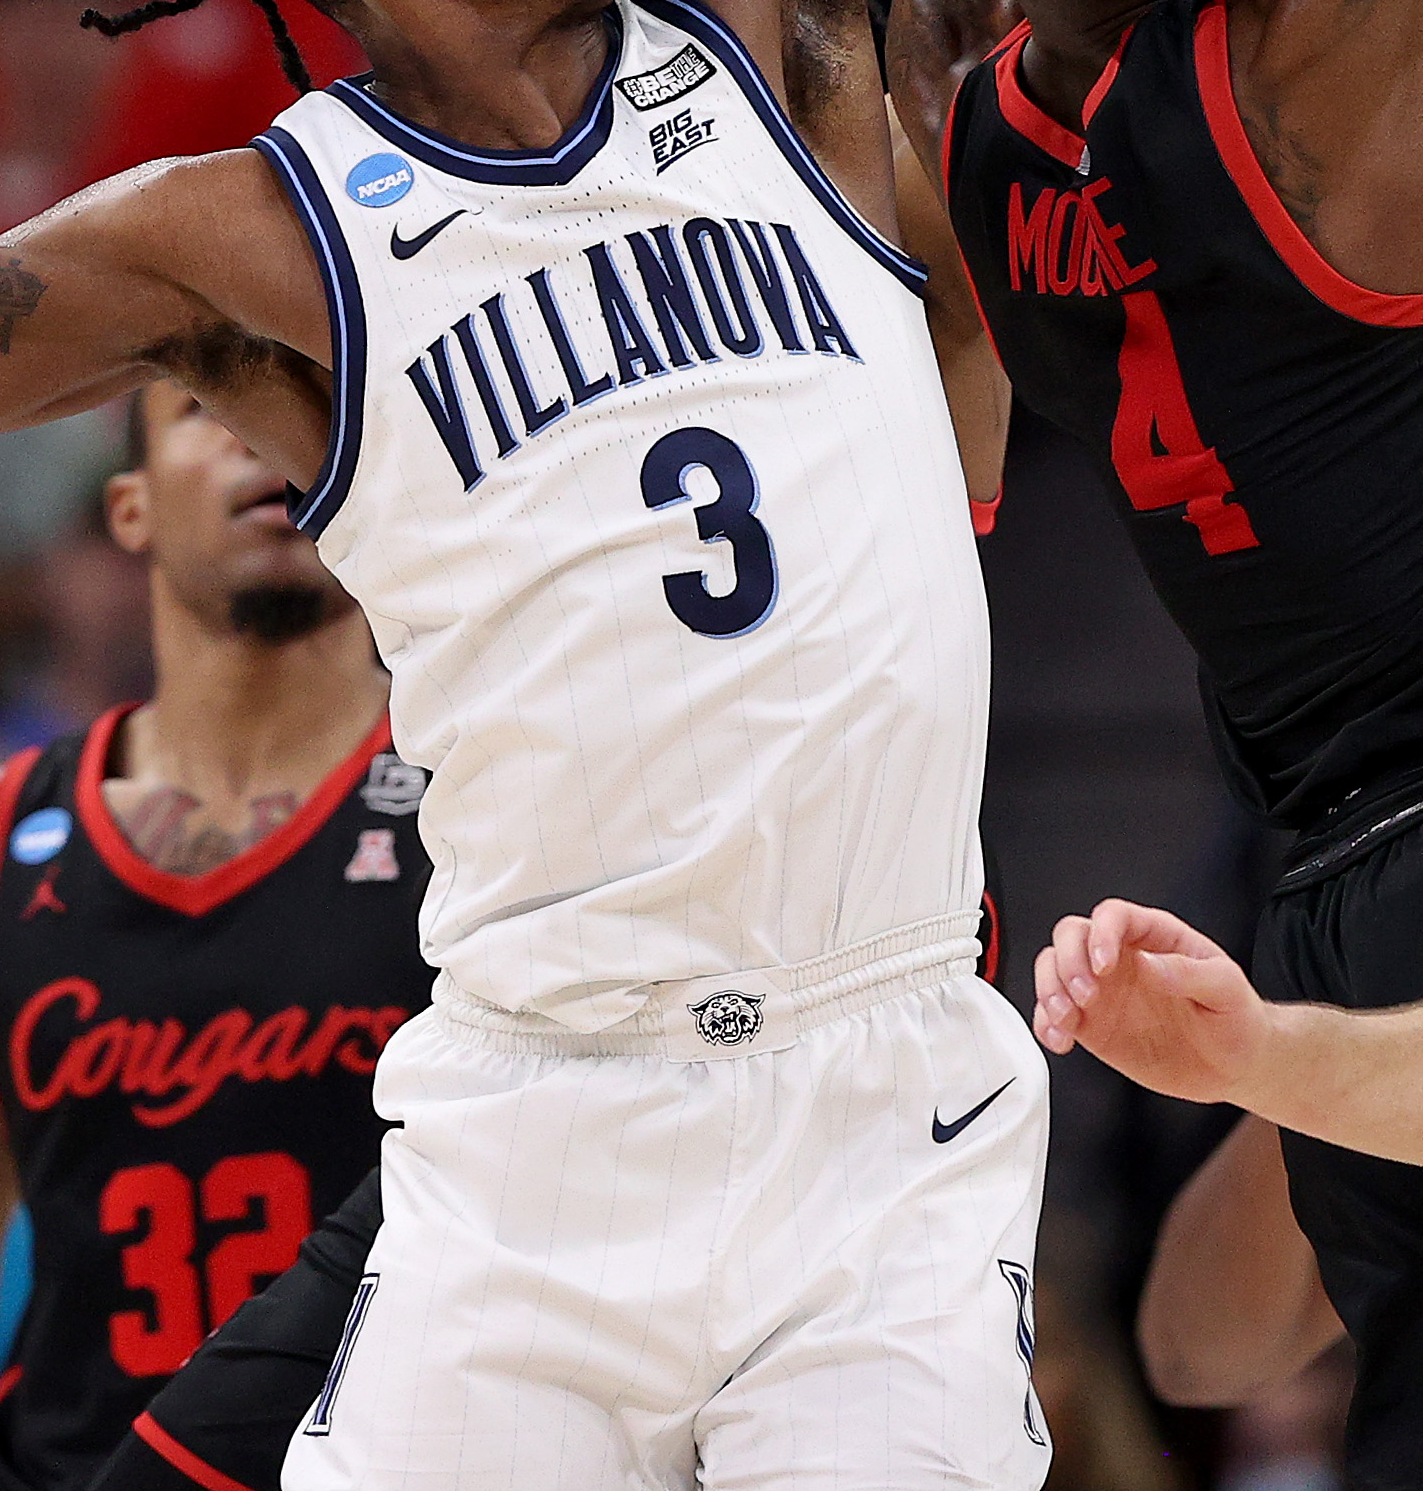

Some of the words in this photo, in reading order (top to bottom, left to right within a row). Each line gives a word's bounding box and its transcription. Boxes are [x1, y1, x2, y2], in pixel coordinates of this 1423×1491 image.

[634, 60, 710, 107] CHANGE
[649, 108, 692, 147] BIG
[653, 118, 716, 165] EAST
[356, 168, 412, 200] NCAA
[405, 216, 866, 494] VILLANOVA
[1111, 290, 1263, 558] 4
[640, 425, 780, 641] 3
[99, 1151, 314, 1378] 32
